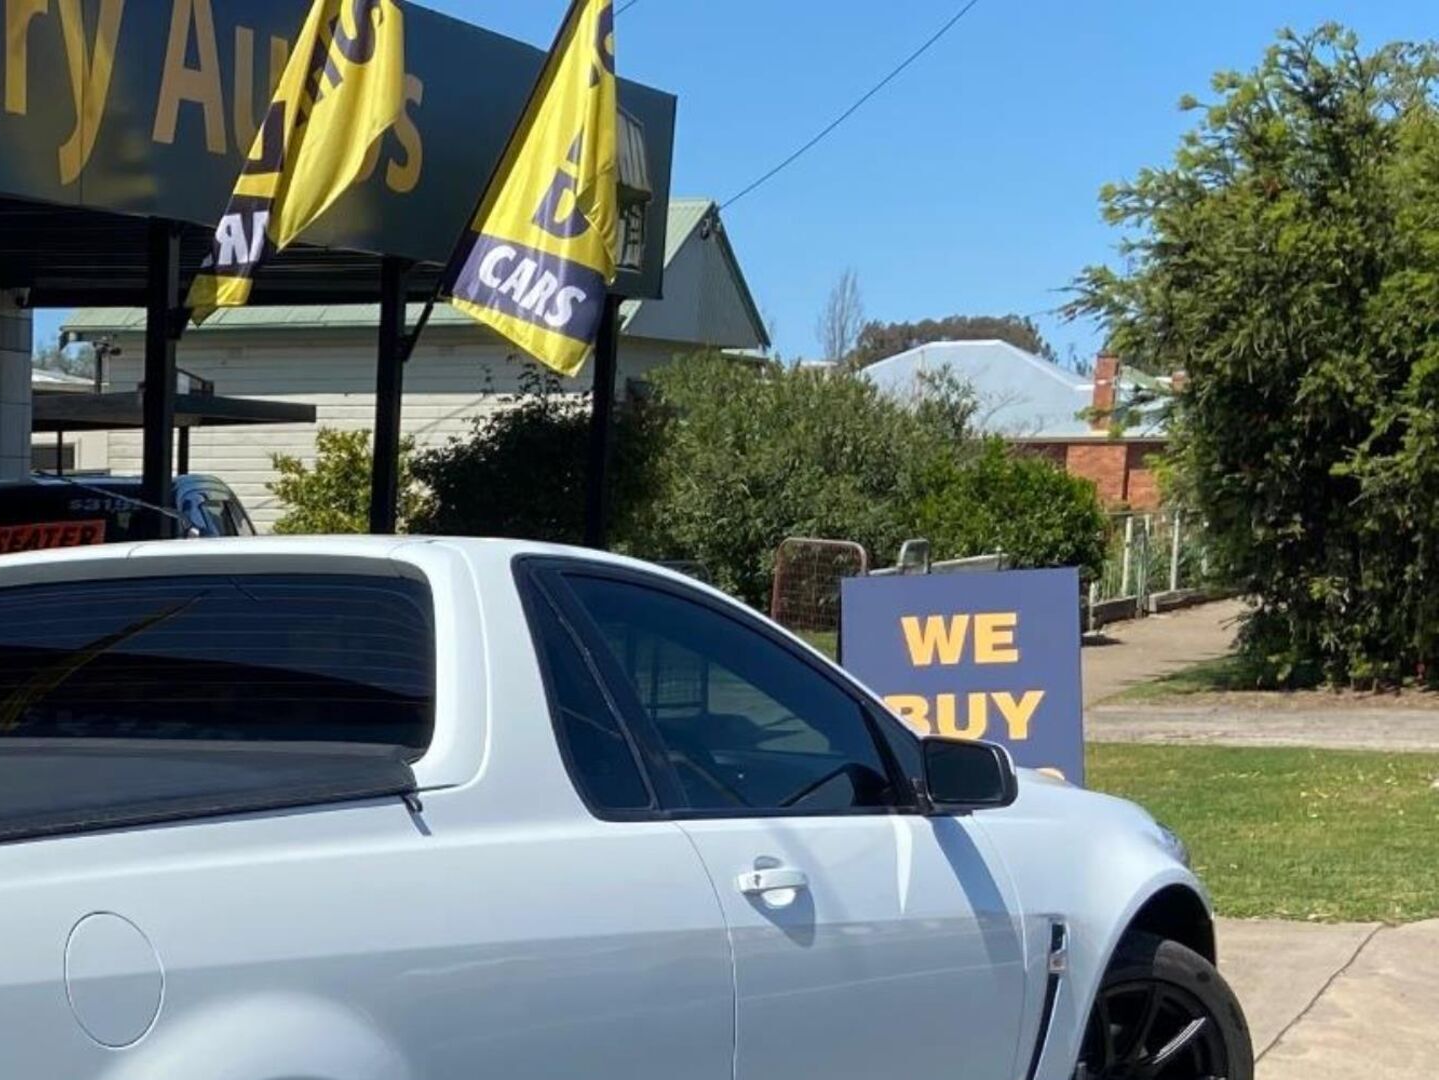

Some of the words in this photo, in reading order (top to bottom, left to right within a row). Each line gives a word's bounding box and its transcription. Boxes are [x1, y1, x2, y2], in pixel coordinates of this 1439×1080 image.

[478, 245, 587, 327] CARS
[900, 612, 1019, 666] WE
[883, 690, 1045, 741] BUY
